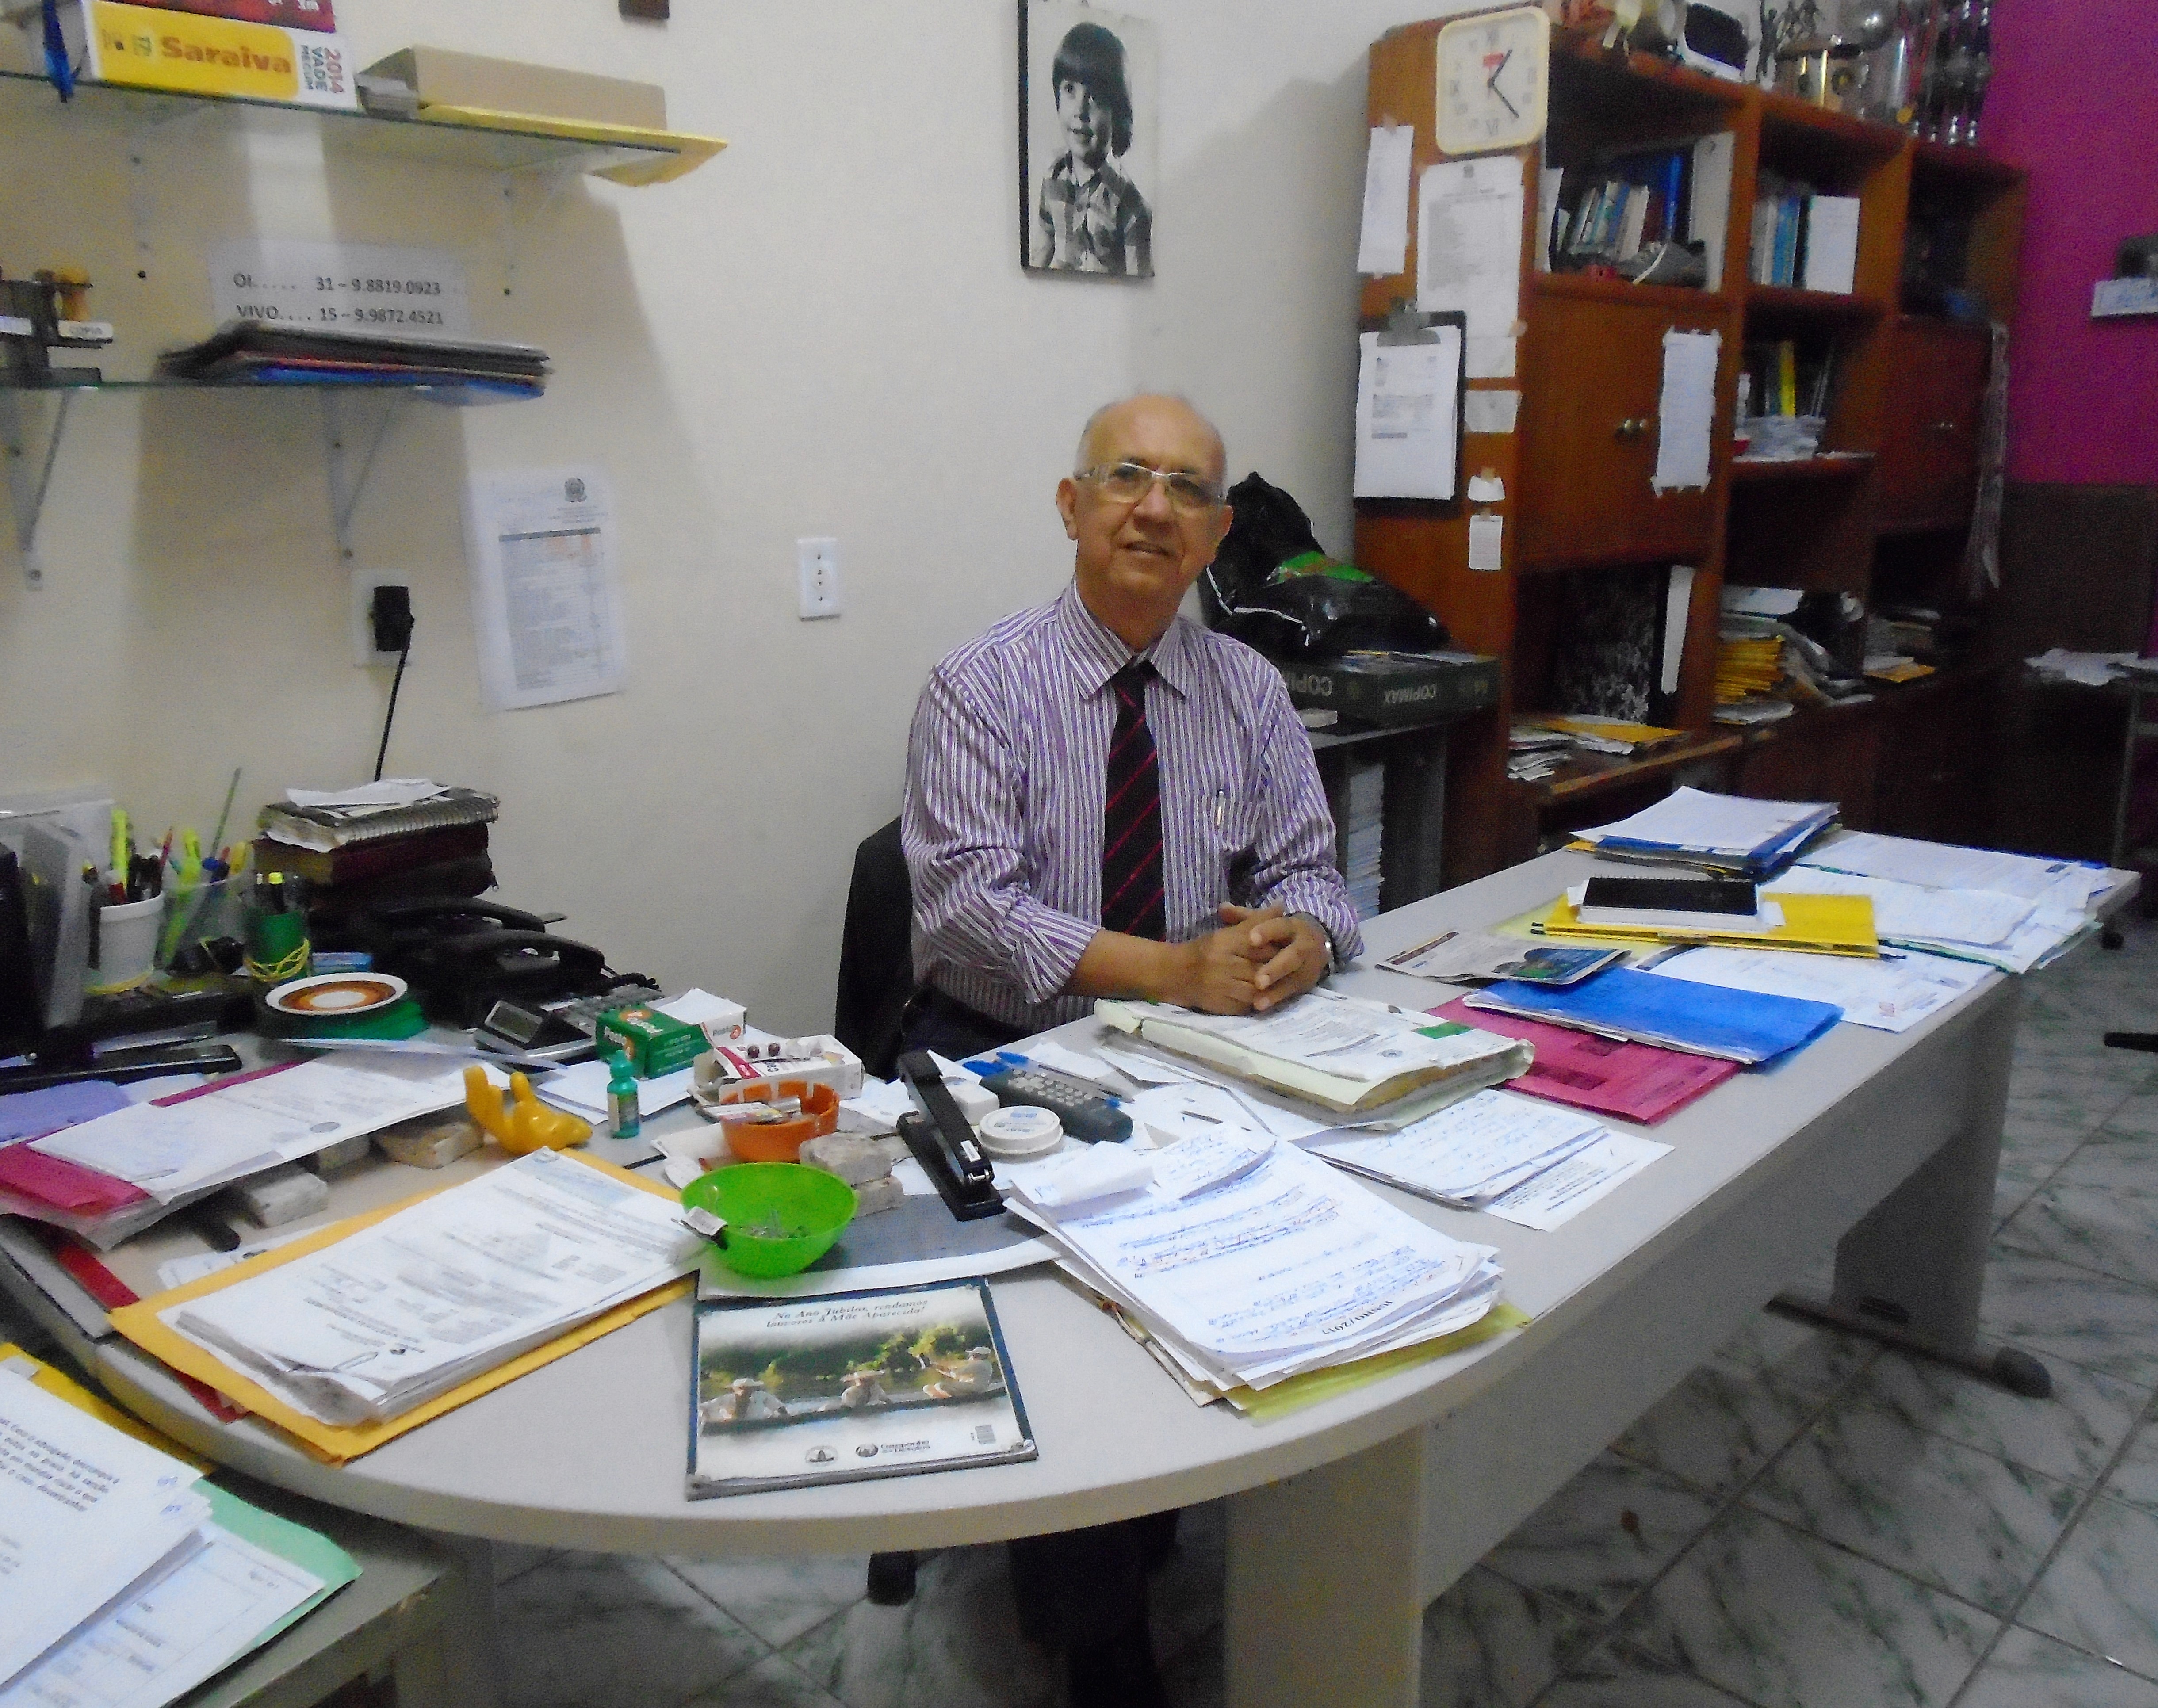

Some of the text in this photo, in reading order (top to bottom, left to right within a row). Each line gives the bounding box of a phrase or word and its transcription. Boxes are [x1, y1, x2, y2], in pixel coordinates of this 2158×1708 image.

[162, 36, 292, 73] Saraiva
[312, 46, 328, 92] VADE
[324, 47, 345, 94] 2014
[317, 277, 334, 291] 31
[320, 307, 337, 321] 15
[1384, 684, 1437, 704] COPIMAX
[795, 1310, 819, 1318] Ano
